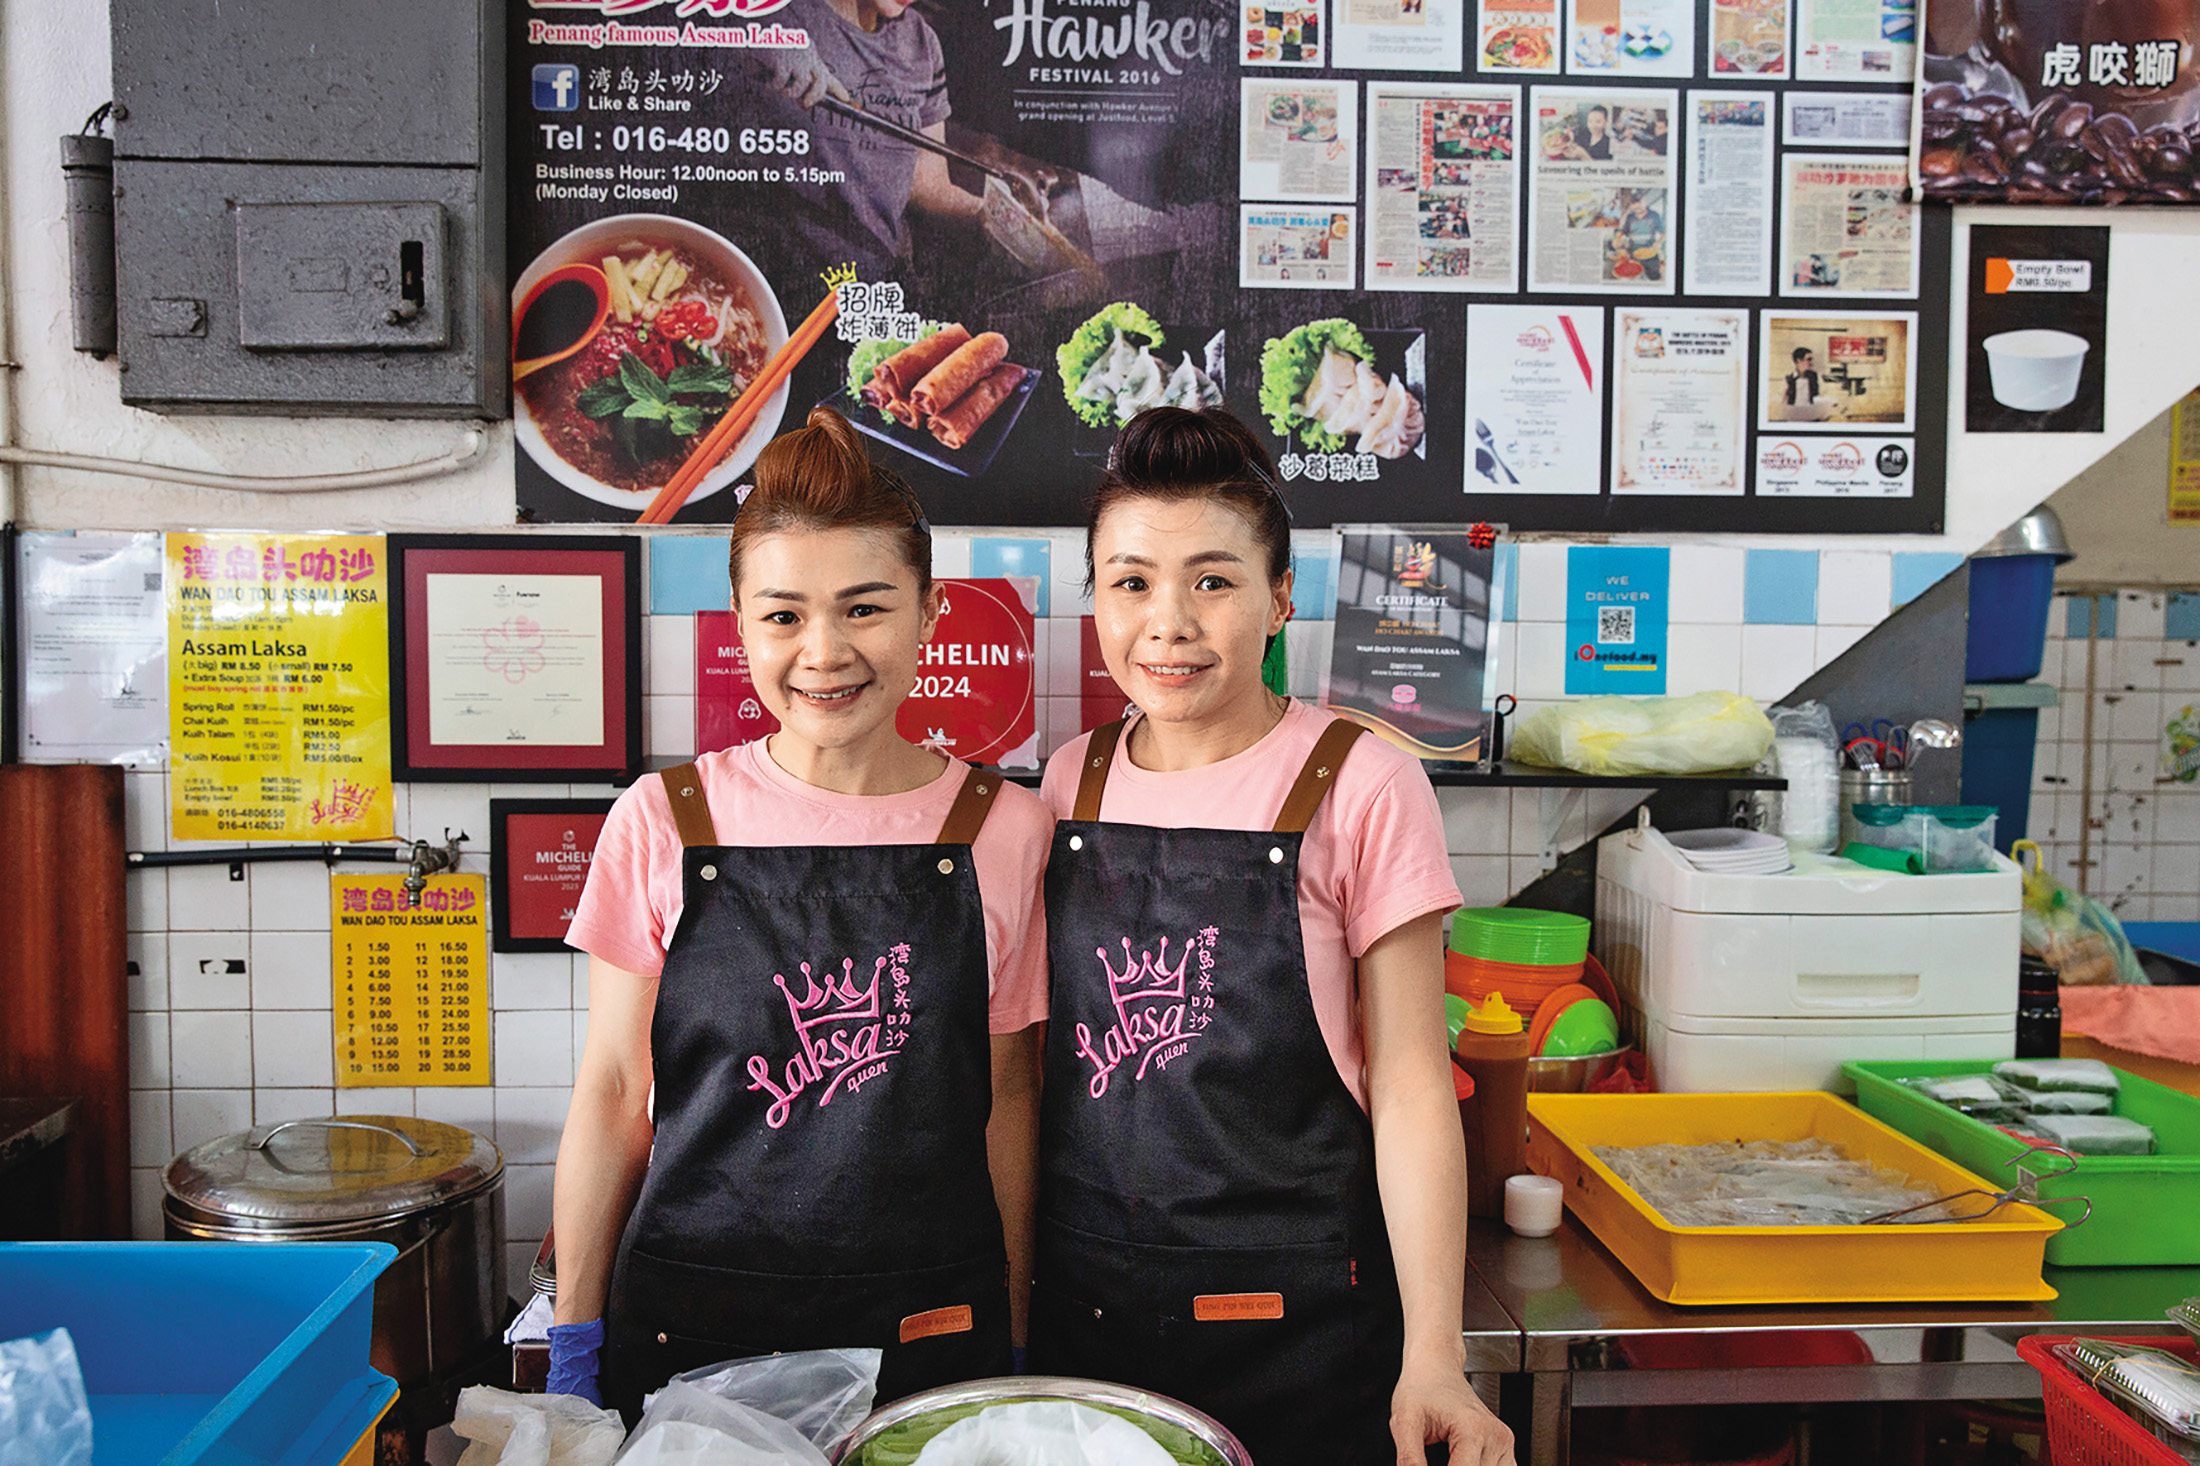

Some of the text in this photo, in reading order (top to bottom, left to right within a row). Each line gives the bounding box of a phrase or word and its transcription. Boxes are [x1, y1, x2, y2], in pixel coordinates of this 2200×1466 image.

[532, 23, 806, 45] Penang famous Assam Laksa
[994, 0, 1231, 75] Hawker
[2042, 41, 2179, 87] 虎咬獅
[588, 67, 723, 95] 湾岛头叻沙
[1029, 68, 1160, 85] FESTIVAL 2016
[588, 96, 691, 112] Like & Share
[1025, 101, 1078, 110] conjunction
[1080, 102, 1100, 110] with
[1102, 102, 1136, 110] Hawker
[1018, 112, 1045, 121] grand
[1047, 113, 1084, 123] opening
[540, 125, 583, 150] Tel
[612, 126, 730, 153] 016-480
[740, 129, 810, 155] 6558
[536, 164, 846, 185] Business Hour: 12.00noon to 5.15pm
[1584, 166, 1598, 175] the
[1628, 167, 1637, 175] of
[536, 185, 679, 204] (Monday Closed)
[2017, 264, 2084, 275] Empty Bowl
[839, 285, 901, 314] 招牌
[839, 315, 918, 340] 炸薄饼
[183, 544, 375, 582] 湾岛头叻沙
[1606, 576, 1629, 585] WE
[180, 586, 378, 603] WAN DAO TOU ASSAM LAKSA
[1585, 592, 1649, 601] DELIVER
[1376, 595, 1448, 607] CERTIFICATE
[182, 640, 307, 657] Assam Laksa
[222, 662, 353, 672] RM 8.50 RM 7.50
[192, 674, 216, 682] Extra
[219, 674, 244, 684] Soup
[302, 674, 323, 683] 6.00
[908, 676, 971, 698] 2024
[183, 703, 214, 712] Spring
[216, 703, 235, 711] Roll
[303, 704, 355, 713] RM1.50/pc
[183, 717, 355, 727] Chai Kuih RM1.50/pc
[183, 731, 341, 739] Kuih Talam RM5.00
[304, 743, 341, 751] RM2.50
[184, 754, 208, 762] Kuih
[211, 754, 240, 762] Kosui
[557, 864, 582, 872] GUIDE
[523, 874, 582, 882] KUALA LUMPUR
[340, 915, 478, 926] WAN DAO TOU ASSAM LAKSA
[347, 942, 467, 952] 1 1.50 11 16.50
[346, 956, 469, 965] 2 3.00 12 18.00
[347, 969, 469, 979] 3 4.50 13 19.50
[1188, 925, 1219, 1030] 湾岛头叻沙
[347, 983, 469, 992] 4 6.00 14 21.00
[886, 942, 912, 1047] 湾岛头叻沙
[347, 996, 469, 1005] 5 7.50 15 22.50
[347, 1010, 470, 1019] 6 9.00 16 24.00
[348, 1023, 470, 1032] 7 10.50 17 25.50
[348, 1036, 470, 1046] 8 12.00 18 27.00
[348, 1050, 471, 1059] 9 13.50 19 28.50
[1075, 1003, 1187, 1099] Laksa
[1155, 1042, 1189, 1071] quen
[350, 1063, 471, 1073] 10 15.00 20 30.00
[746, 1022, 882, 1129] Laksa
[847, 1061, 889, 1093] quen
